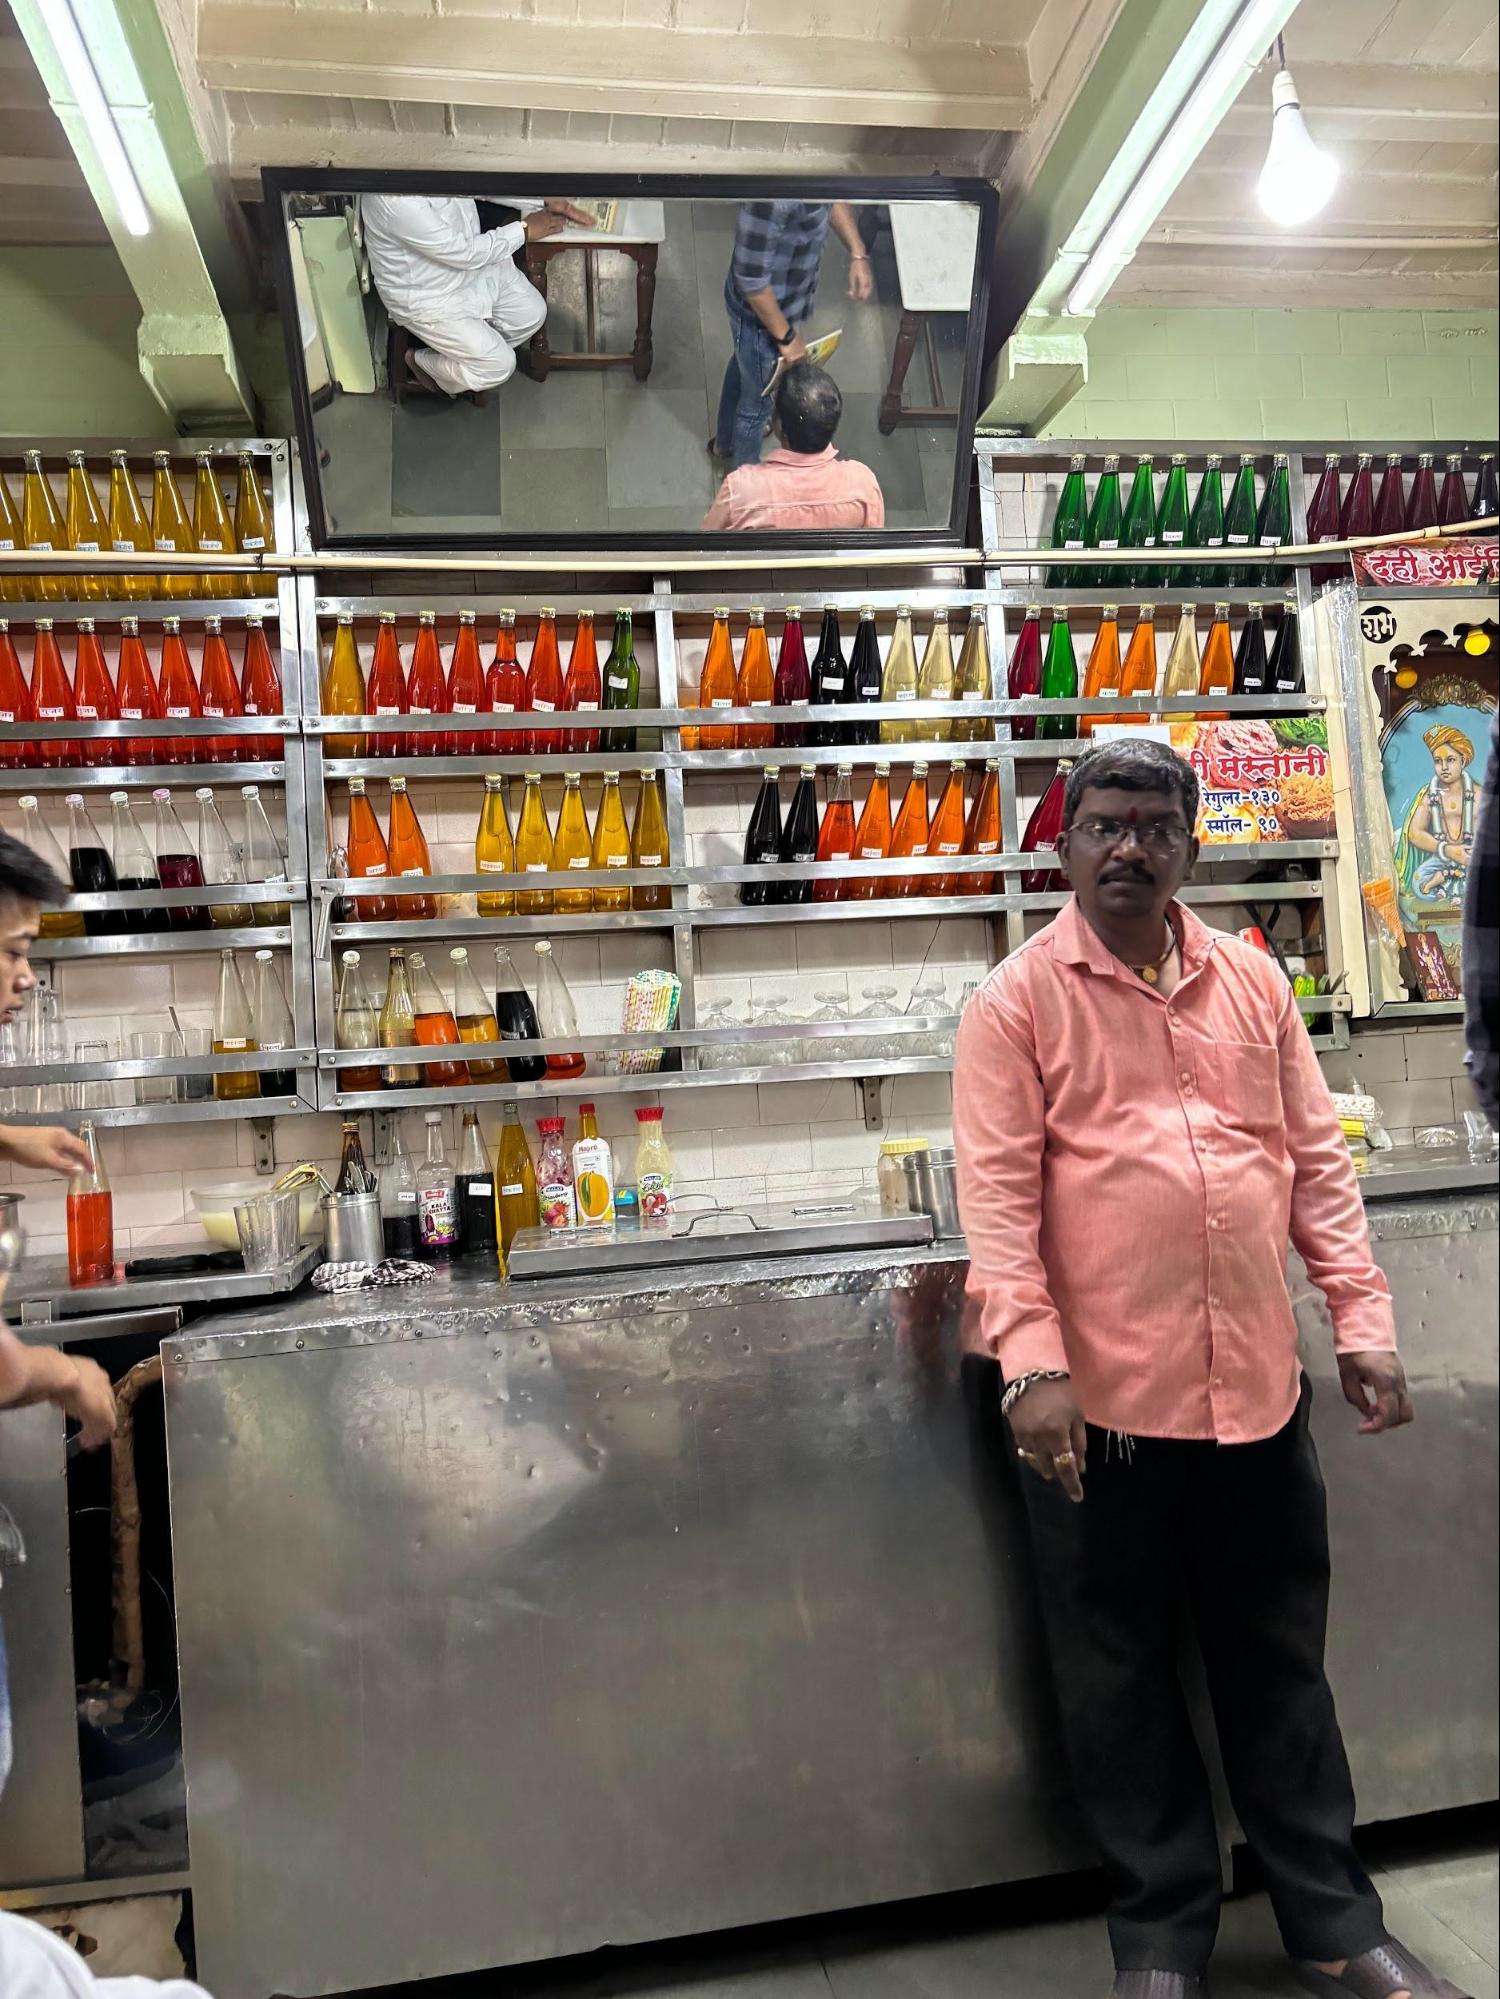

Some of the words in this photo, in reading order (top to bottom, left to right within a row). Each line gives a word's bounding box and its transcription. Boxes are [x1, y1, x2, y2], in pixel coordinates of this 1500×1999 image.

[1368, 547, 1419, 582] दही
[1360, 611, 1394, 641] शुभ
[1217, 746, 1328, 781] मस्तानी
[431, 1201, 447, 1209] KALA
